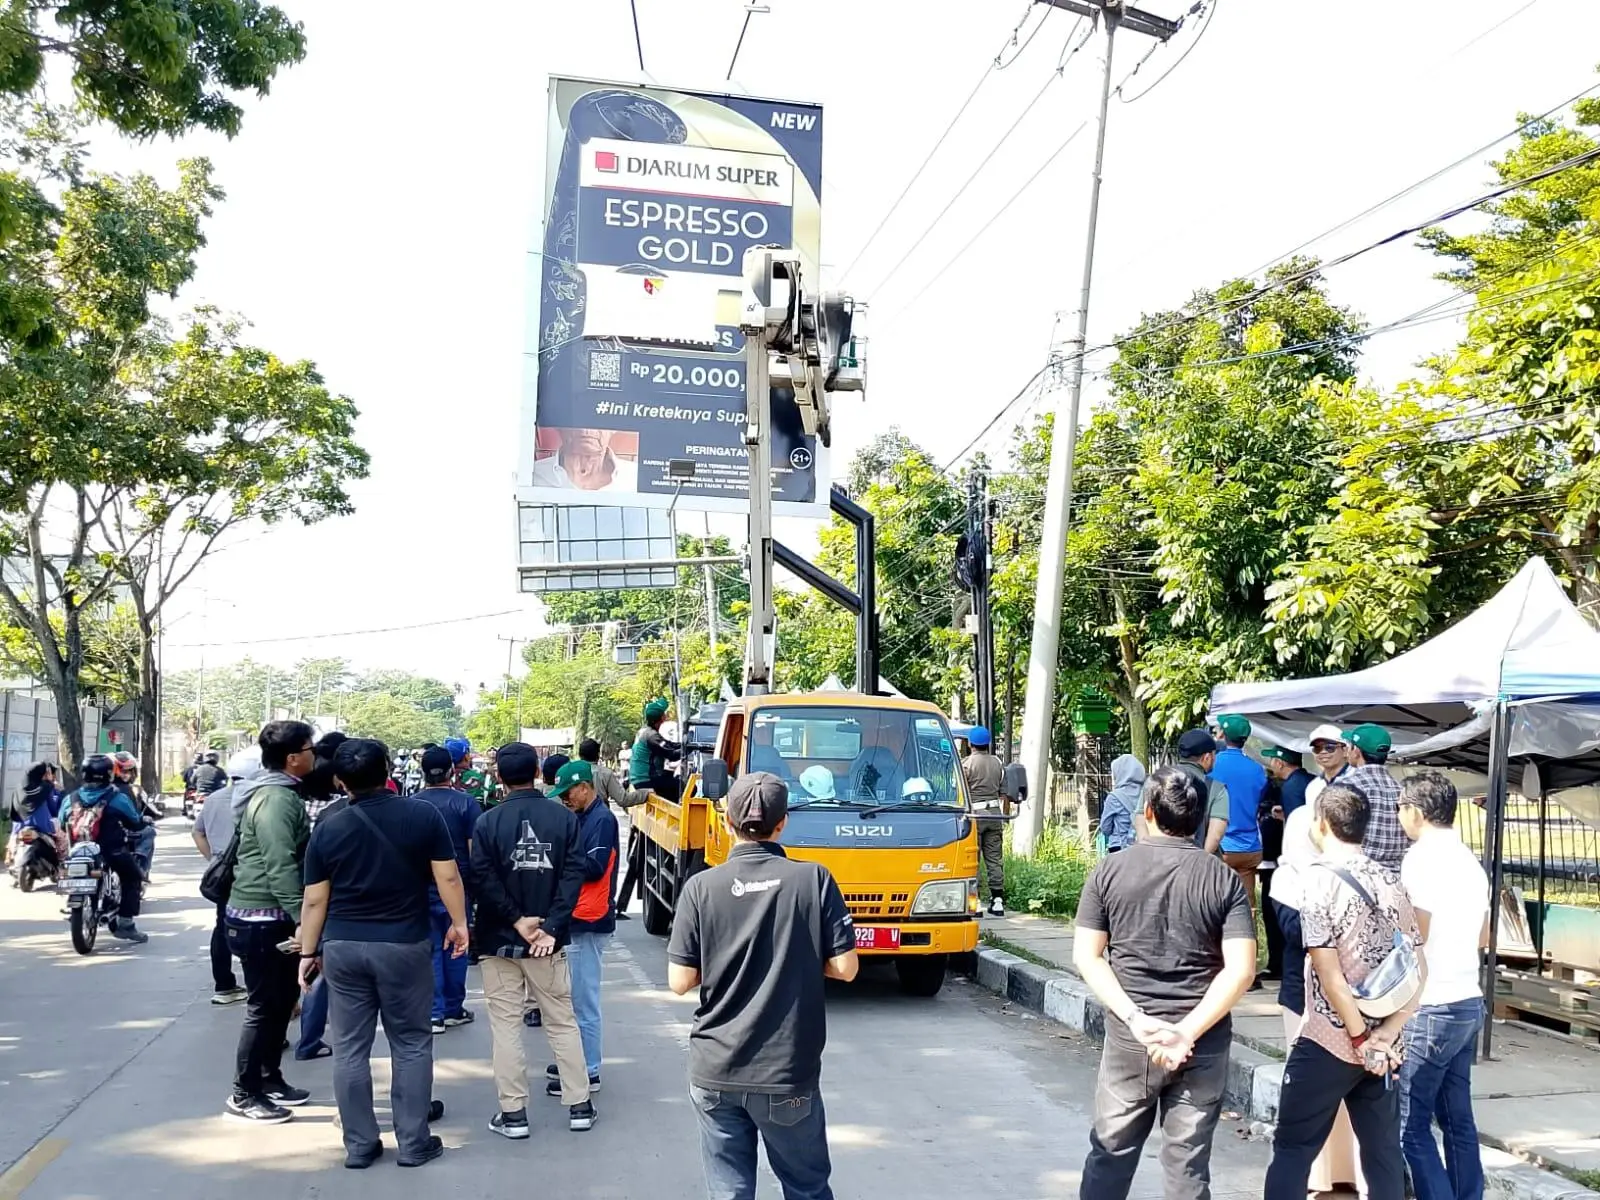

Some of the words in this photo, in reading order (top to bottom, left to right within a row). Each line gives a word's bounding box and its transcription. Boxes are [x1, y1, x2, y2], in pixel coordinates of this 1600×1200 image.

[770, 111, 817, 131] NEW
[627, 157, 710, 180] DJARUM
[716, 166, 780, 187] SUPER
[604, 198, 769, 239] ESPRESSO
[638, 235, 734, 266] GOLD
[630, 362, 650, 378] Rp
[595, 401, 629, 416] #Ini
[633, 403, 711, 424] Kreteknya
[793, 453, 809, 463] 21+
[835, 825, 893, 837] ISUZU
[854, 928, 875, 941] 920
[891, 929, 898, 942] V
